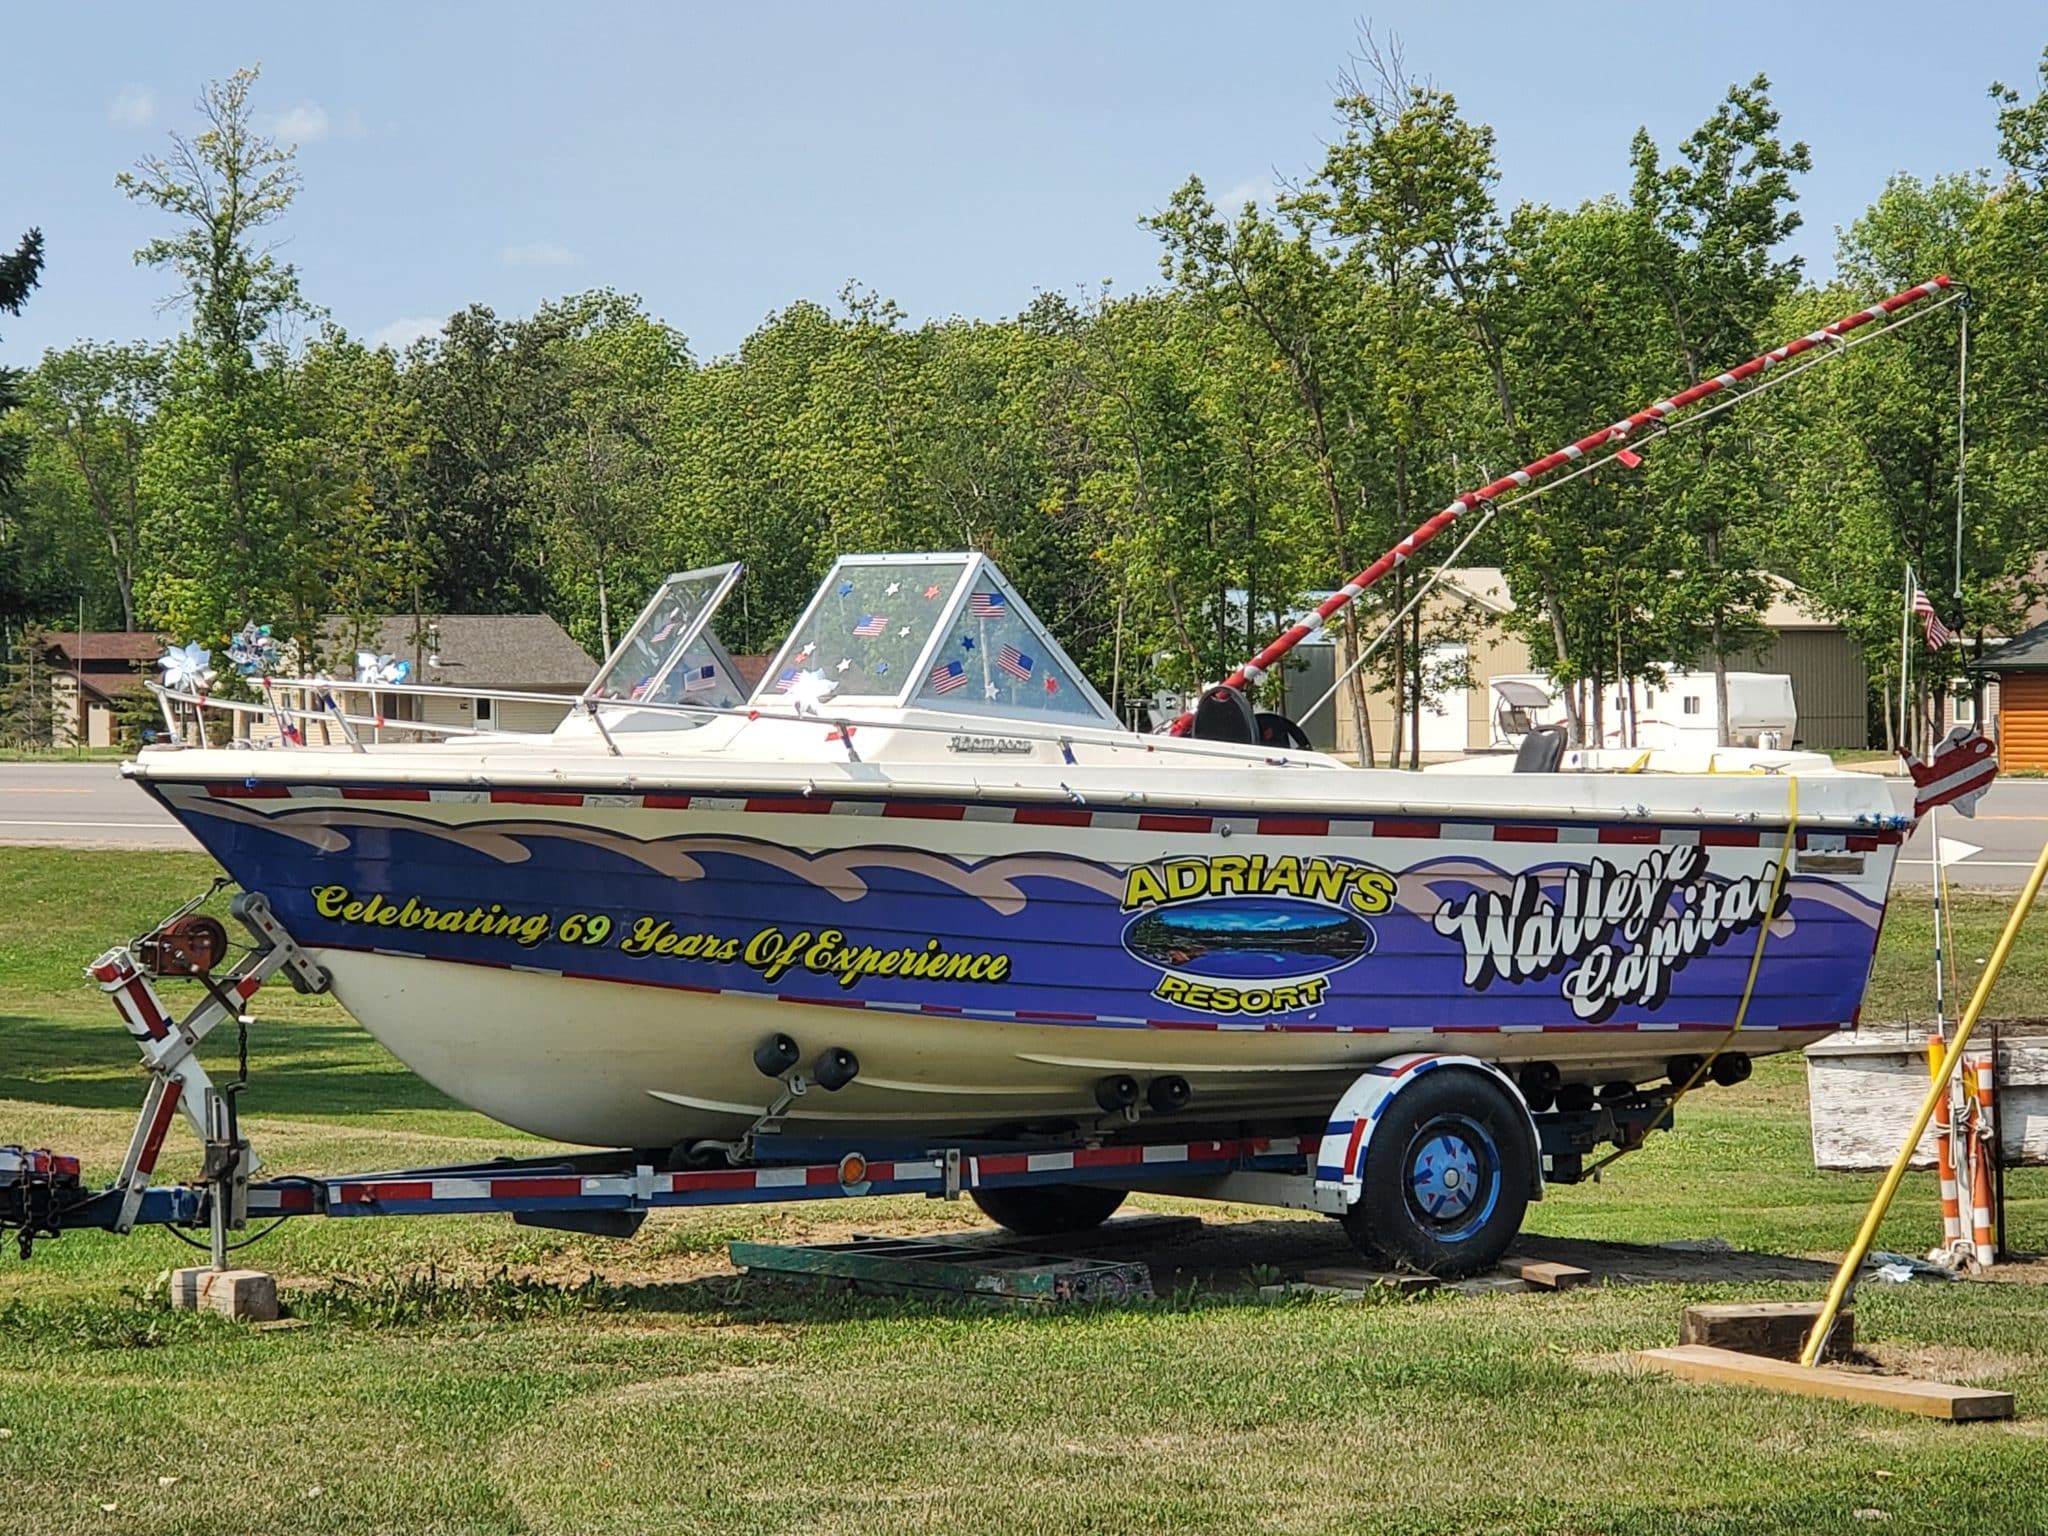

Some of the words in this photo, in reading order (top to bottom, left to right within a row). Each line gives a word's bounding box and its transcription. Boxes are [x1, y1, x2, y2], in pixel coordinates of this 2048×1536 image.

[1122, 854, 1396, 914] ADRIAN'S
[1435, 844, 1702, 986] Walleye
[311, 885, 551, 945] Celebrating
[558, 913, 613, 946] 69
[620, 916, 740, 956] Years
[743, 927, 812, 980] Of
[803, 929, 1011, 987] Experience
[1561, 860, 1788, 1020] Capital
[1155, 975, 1326, 1013] RESORT
